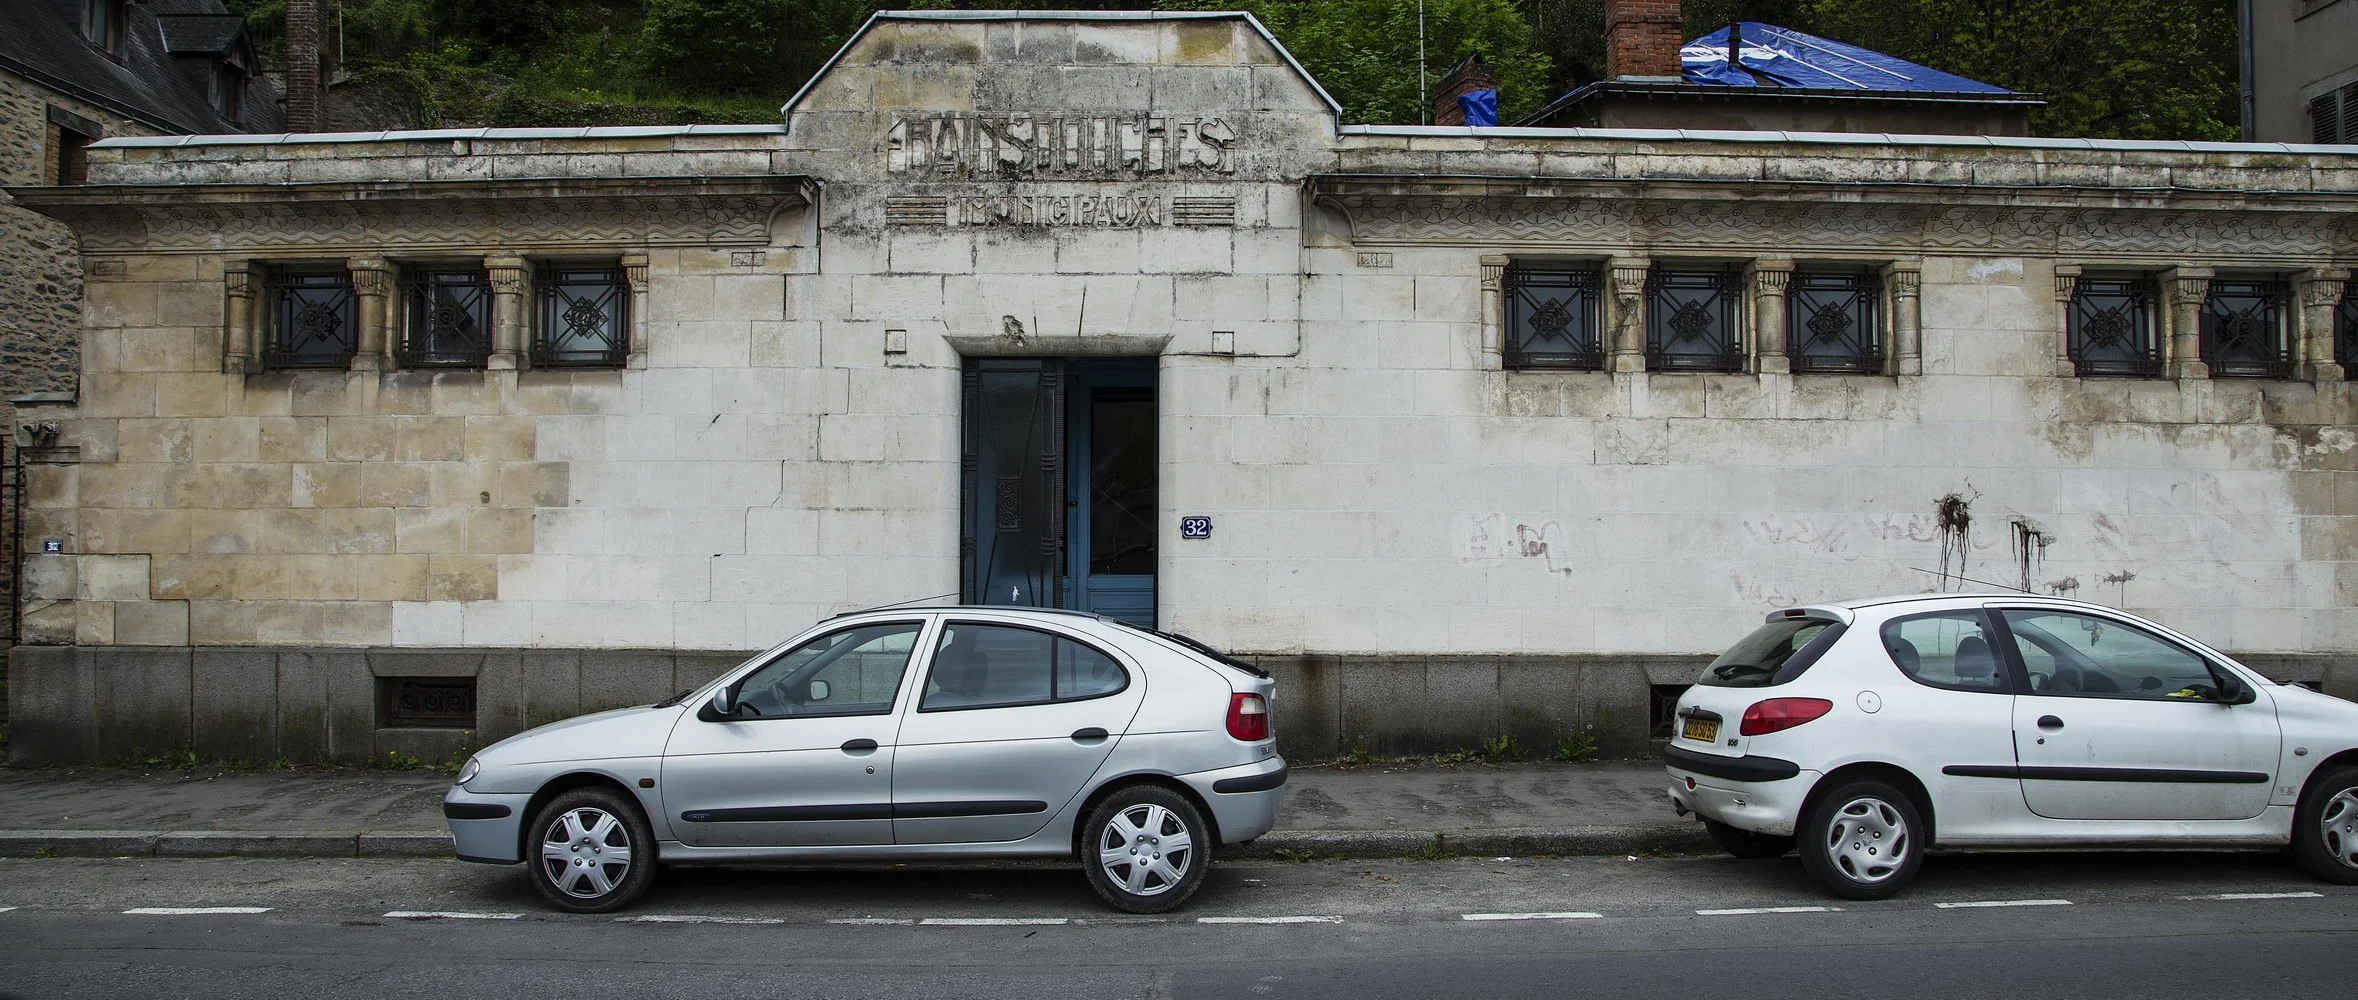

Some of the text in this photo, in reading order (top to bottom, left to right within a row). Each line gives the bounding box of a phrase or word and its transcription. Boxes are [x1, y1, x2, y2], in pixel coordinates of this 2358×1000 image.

[965, 195, 1153, 227] MUNICIPAUX
[1185, 519, 1207, 536] 32
[47, 542, 59, 551] 32
